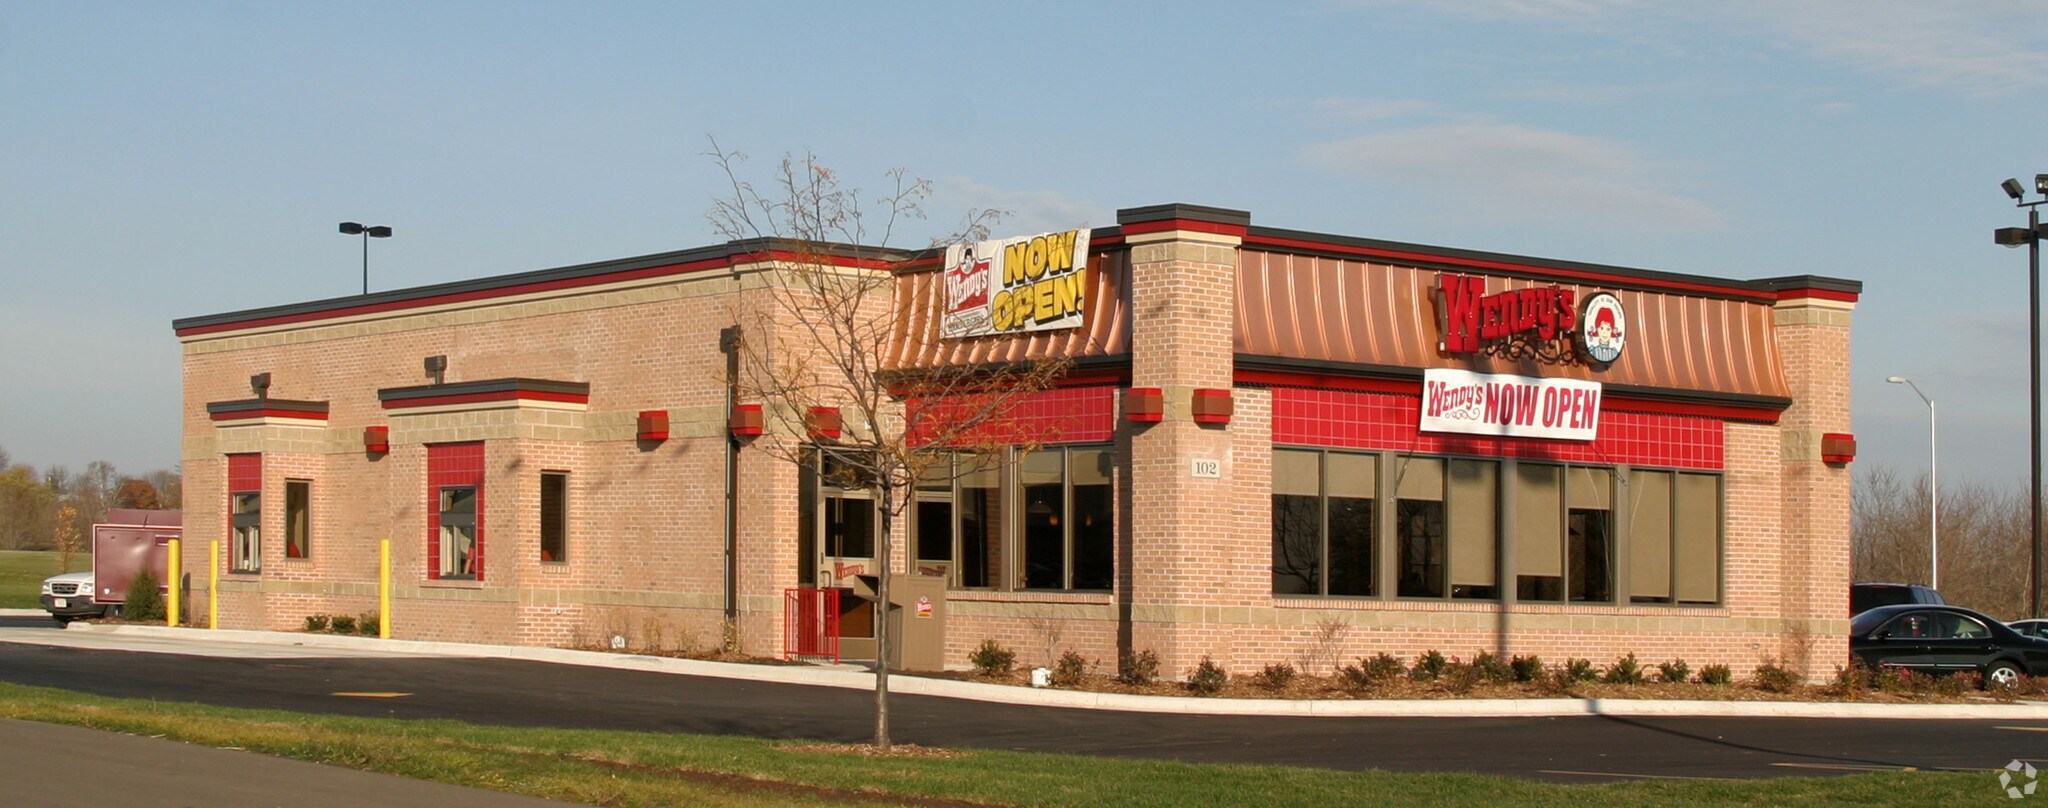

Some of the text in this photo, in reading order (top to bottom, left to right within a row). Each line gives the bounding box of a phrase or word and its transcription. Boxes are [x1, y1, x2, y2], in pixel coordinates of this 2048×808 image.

[1003, 230, 1078, 288] NOW
[947, 268, 988, 311] Wendy's
[992, 268, 1085, 331] OPEN!
[1440, 274, 1576, 353] Wendy's
[1427, 381, 1598, 430] Wendy's NOW OPEN
[1196, 461, 1217, 475] 102
